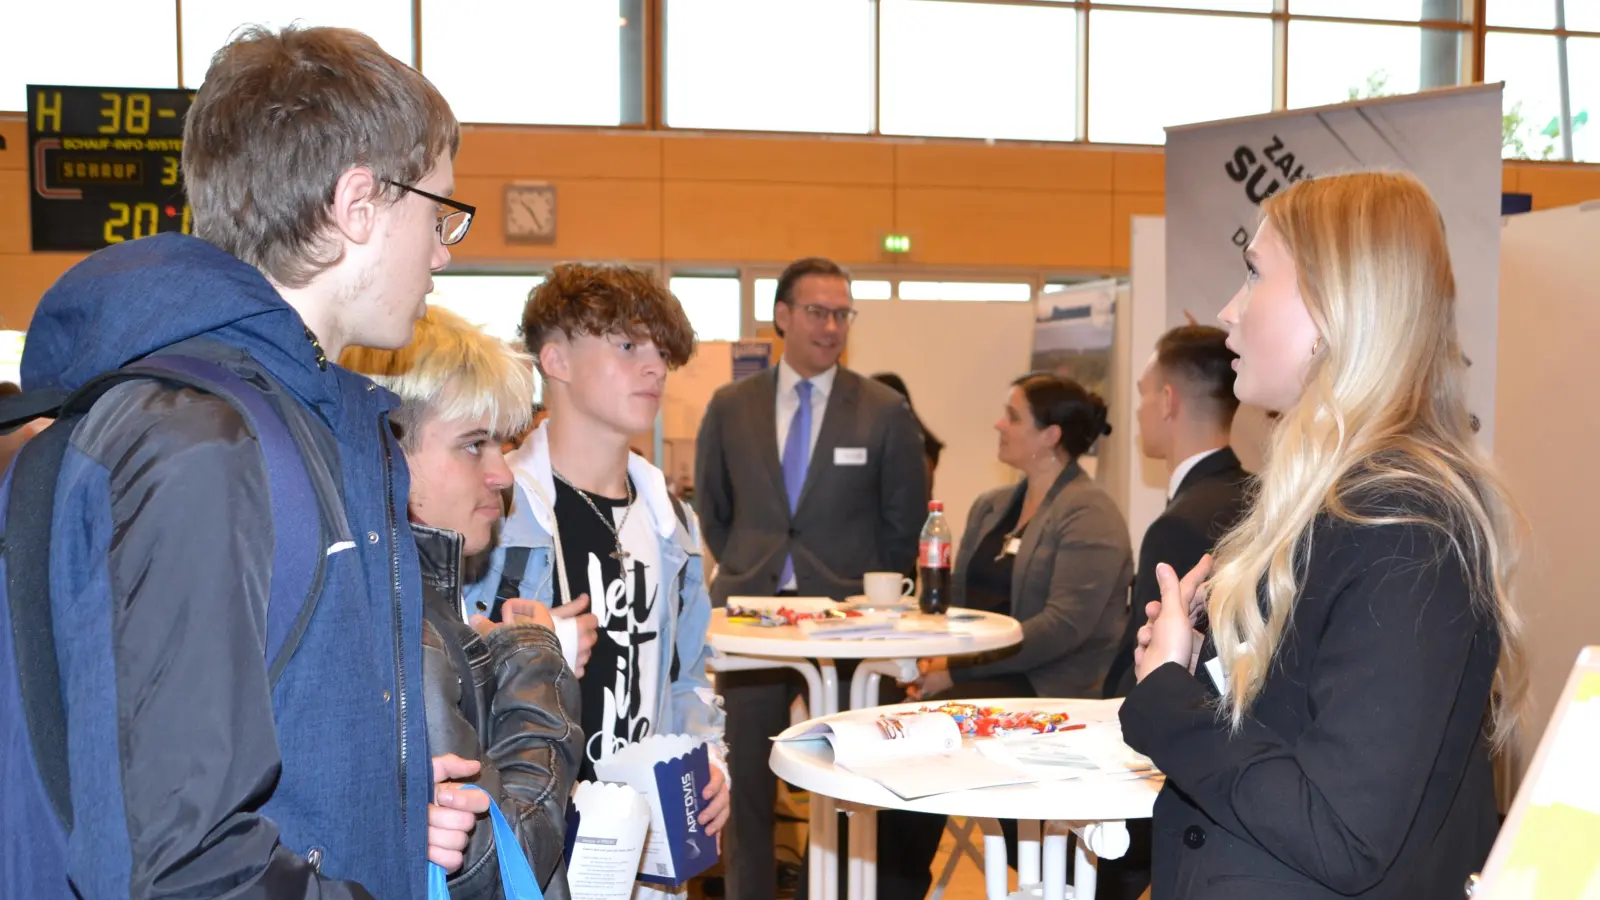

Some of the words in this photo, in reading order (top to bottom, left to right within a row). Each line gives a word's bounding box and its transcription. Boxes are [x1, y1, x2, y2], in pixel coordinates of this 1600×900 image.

[36, 91, 62, 132] H
[98, 93, 197, 134] 38-
[63, 137, 184, 151] SCHAUF-INFO-SYSTE
[1263, 134, 1314, 184] ZAH
[1225, 145, 1280, 205] SU
